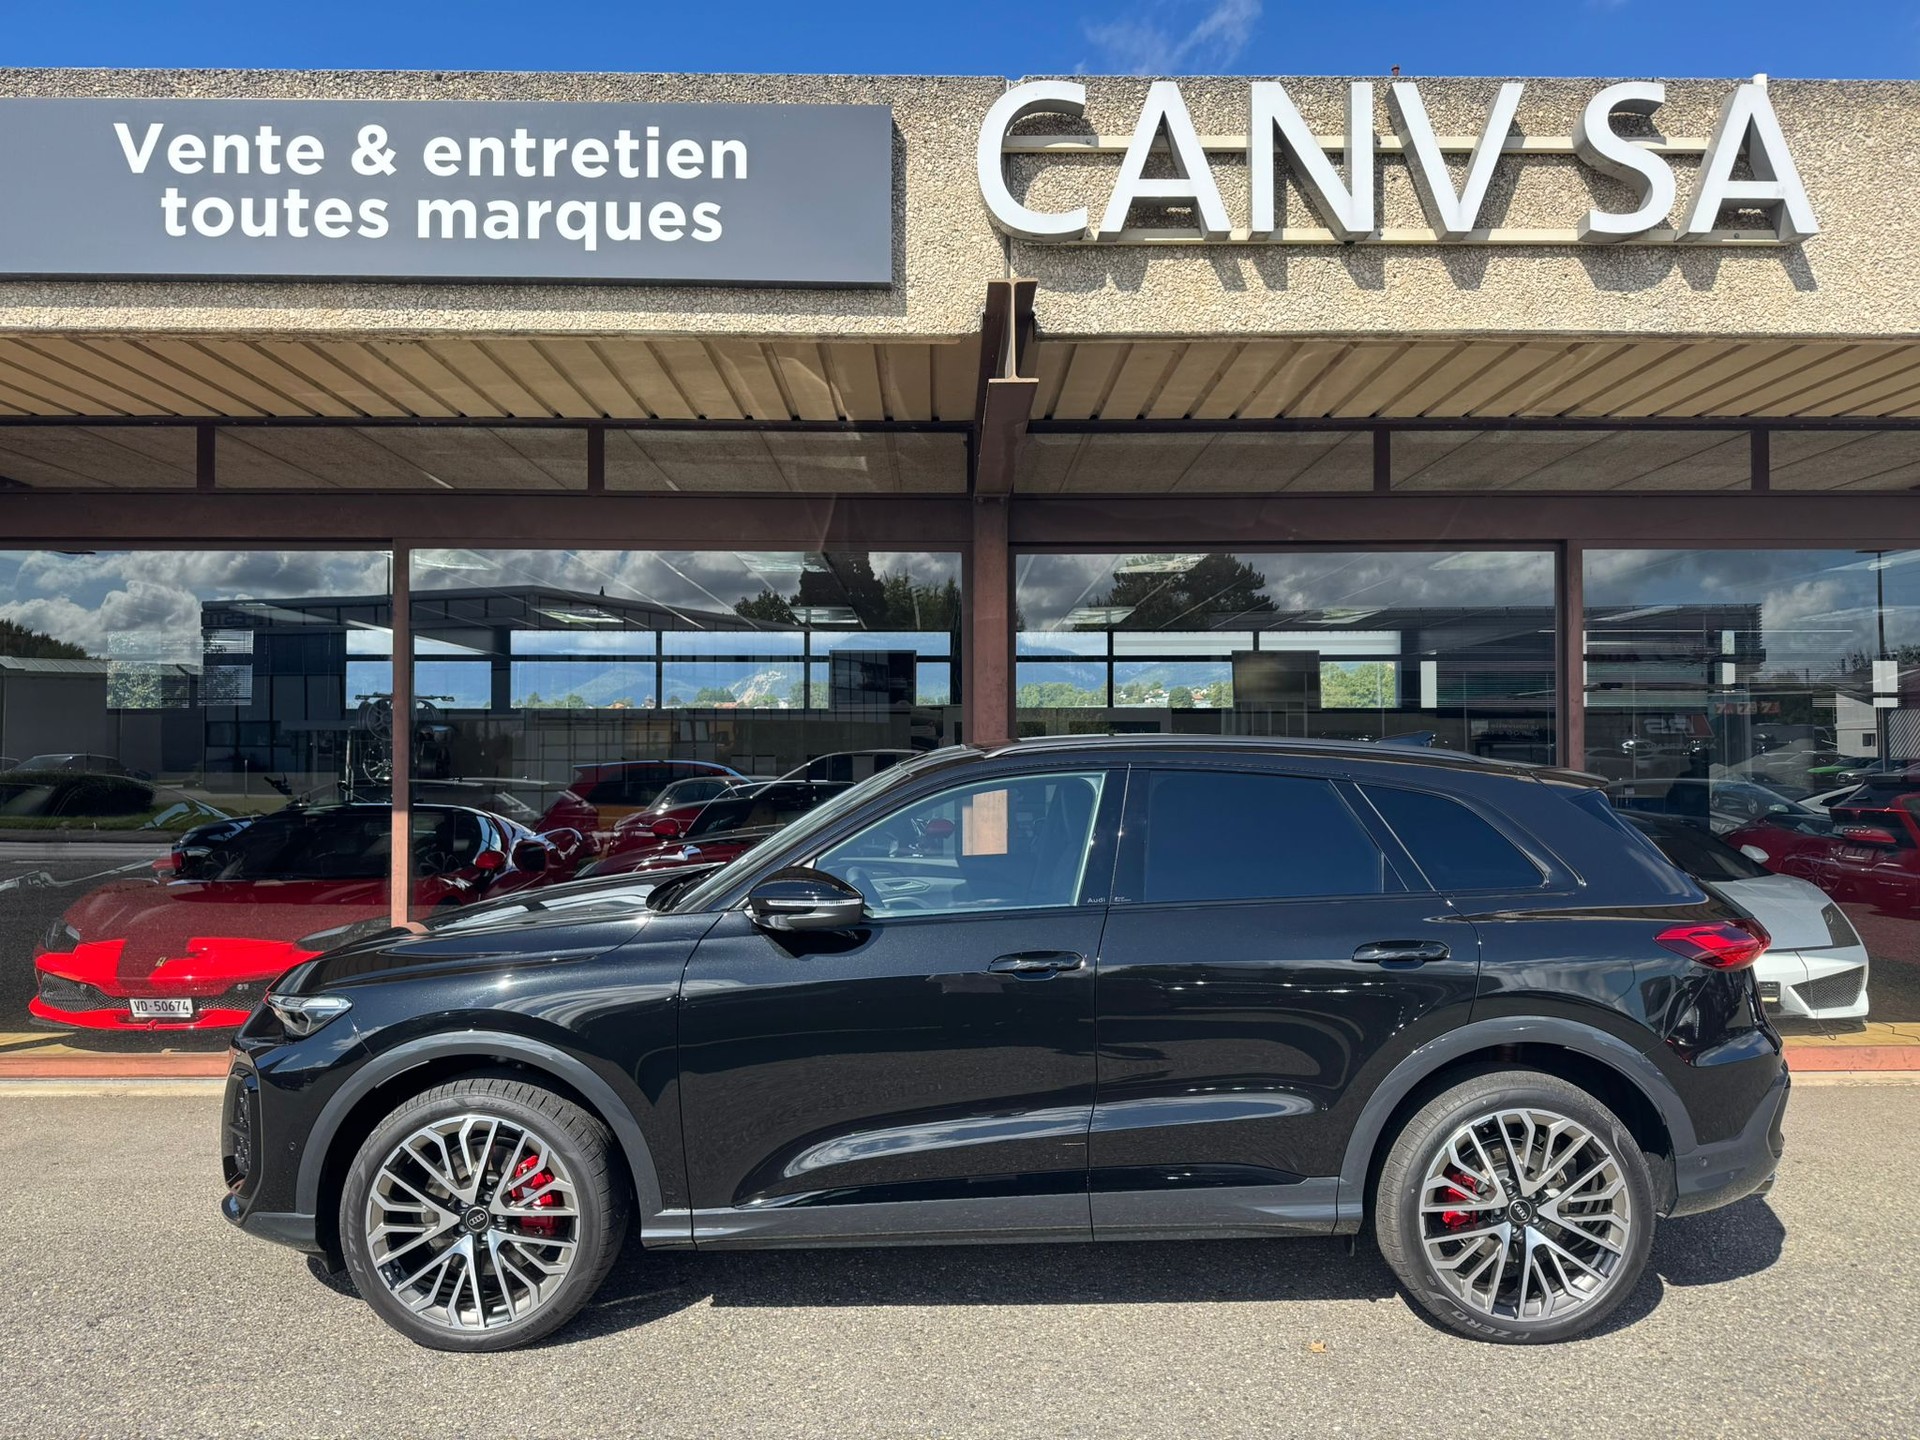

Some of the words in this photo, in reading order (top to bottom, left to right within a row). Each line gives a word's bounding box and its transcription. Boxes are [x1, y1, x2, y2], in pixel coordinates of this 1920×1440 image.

[113, 122, 325, 175] Vente
[351, 124, 397, 177] &
[423, 126, 747, 179] entretien
[976, 80, 1525, 238] CANV
[1577, 80, 1820, 238] SA
[161, 187, 389, 239] toutes
[417, 199, 723, 251] marques
[1450, 1310, 1513, 1339] ZERO
[1514, 1332, 1531, 1341] P
